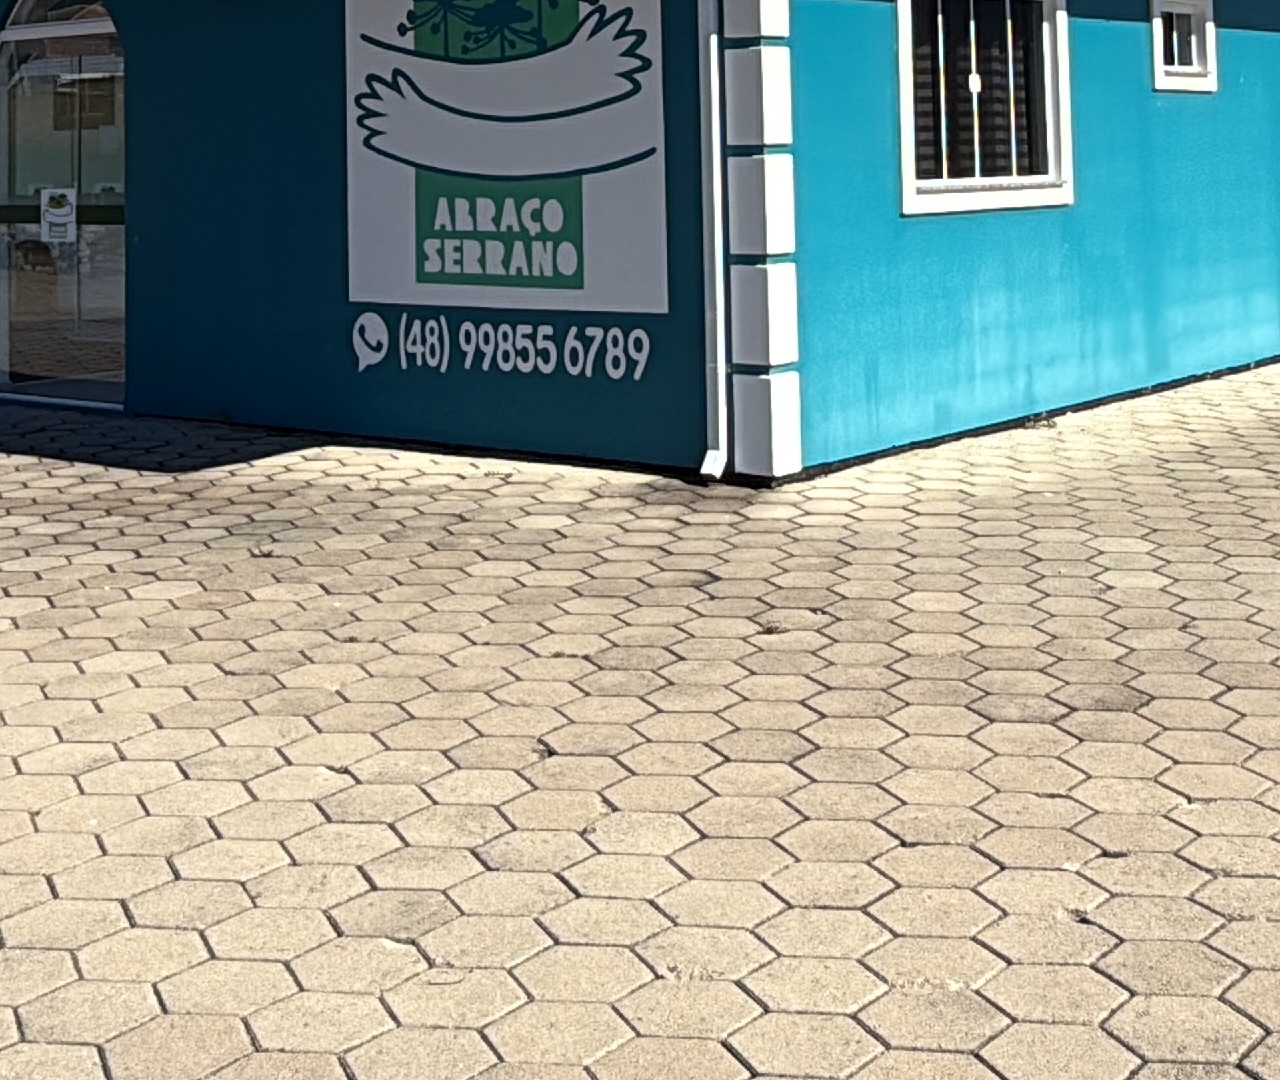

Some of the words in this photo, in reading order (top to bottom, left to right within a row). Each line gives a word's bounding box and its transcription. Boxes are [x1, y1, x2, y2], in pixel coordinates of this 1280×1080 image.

[433, 196, 564, 237] ABRAÇO
[423, 238, 578, 277] SERRANO
[399, 312, 450, 374] (48)
[458, 320, 558, 374] 99855
[563, 325, 650, 381] 6789
